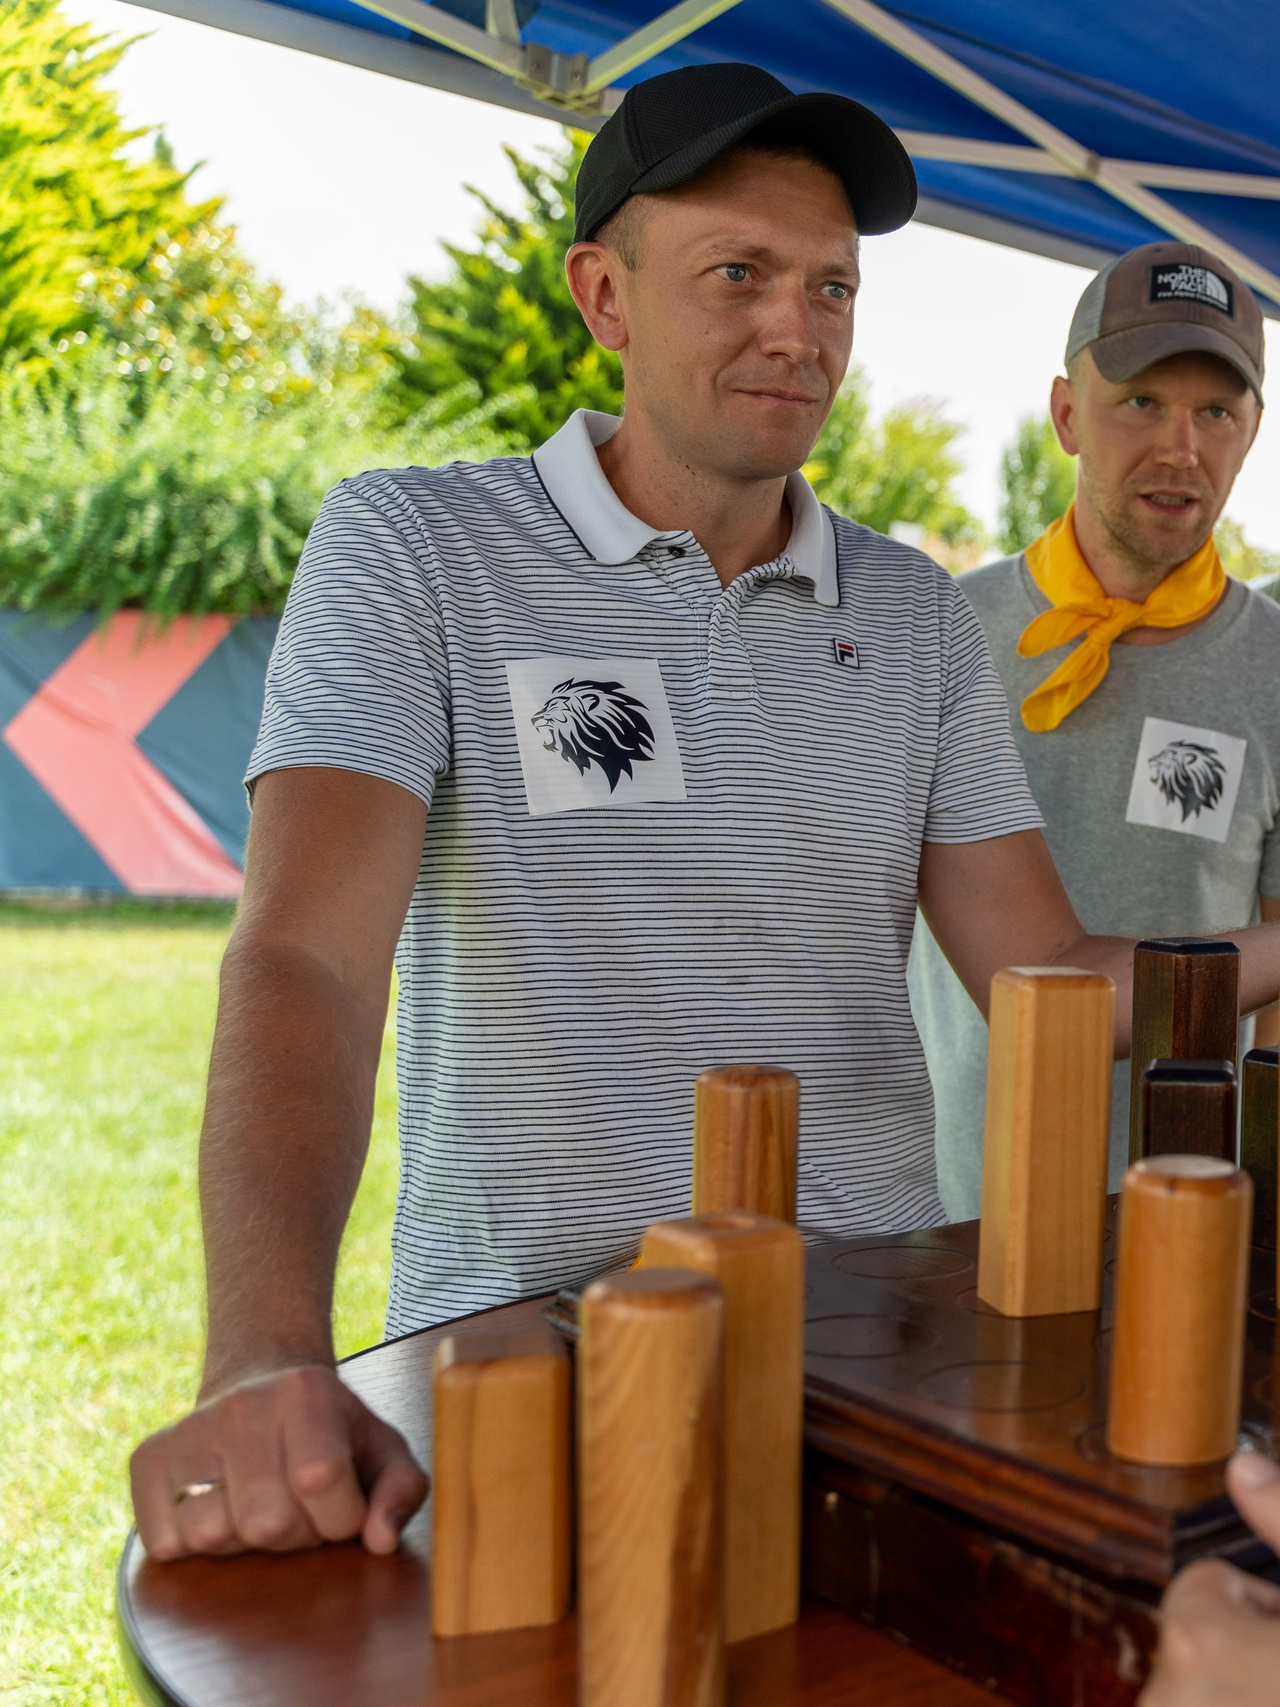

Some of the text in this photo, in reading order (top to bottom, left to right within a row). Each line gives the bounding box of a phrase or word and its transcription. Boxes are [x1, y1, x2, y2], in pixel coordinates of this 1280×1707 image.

[1178, 264, 1206, 276] THE
[1157, 272, 1206, 285] NORTH
[1170, 281, 1207, 294] FACE
